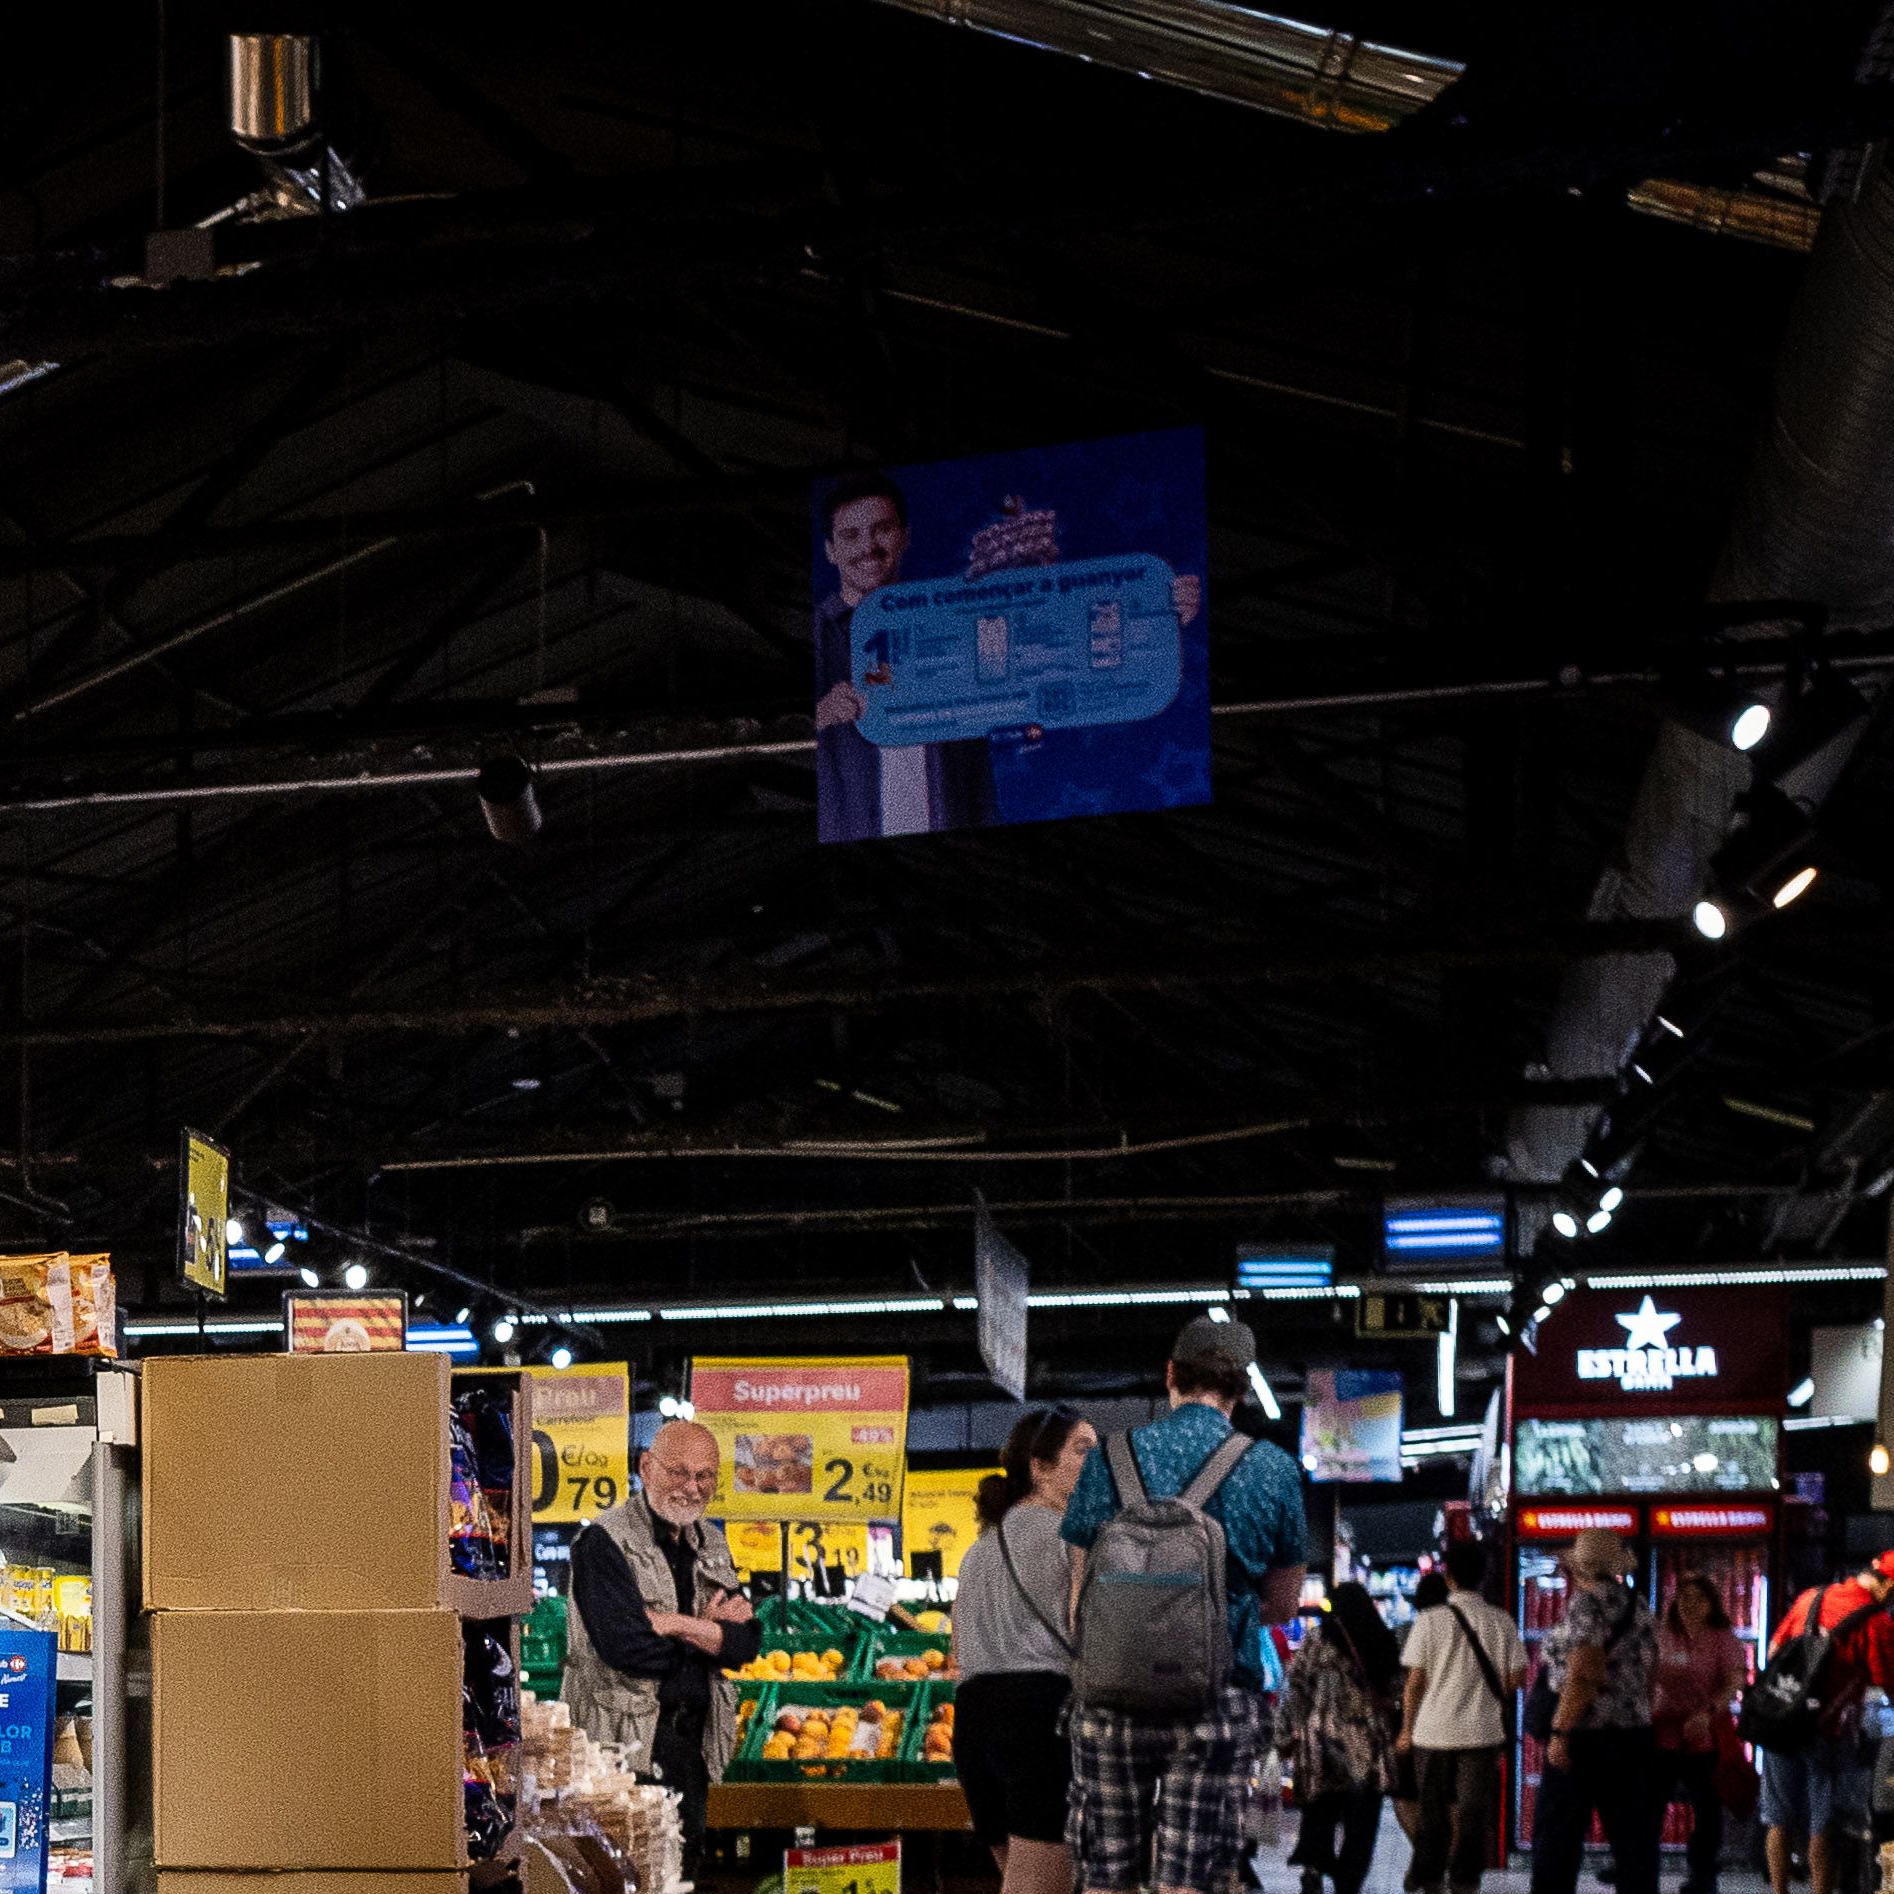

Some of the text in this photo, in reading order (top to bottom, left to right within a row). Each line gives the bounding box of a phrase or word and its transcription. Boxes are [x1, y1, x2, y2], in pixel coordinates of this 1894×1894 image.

[1577, 1346, 1717, 1379] ESTRELLA
[733, 1380, 862, 1403] Superpreu
[566, 1476, 617, 1512] 79
[823, 1457, 893, 1507] 2,49
